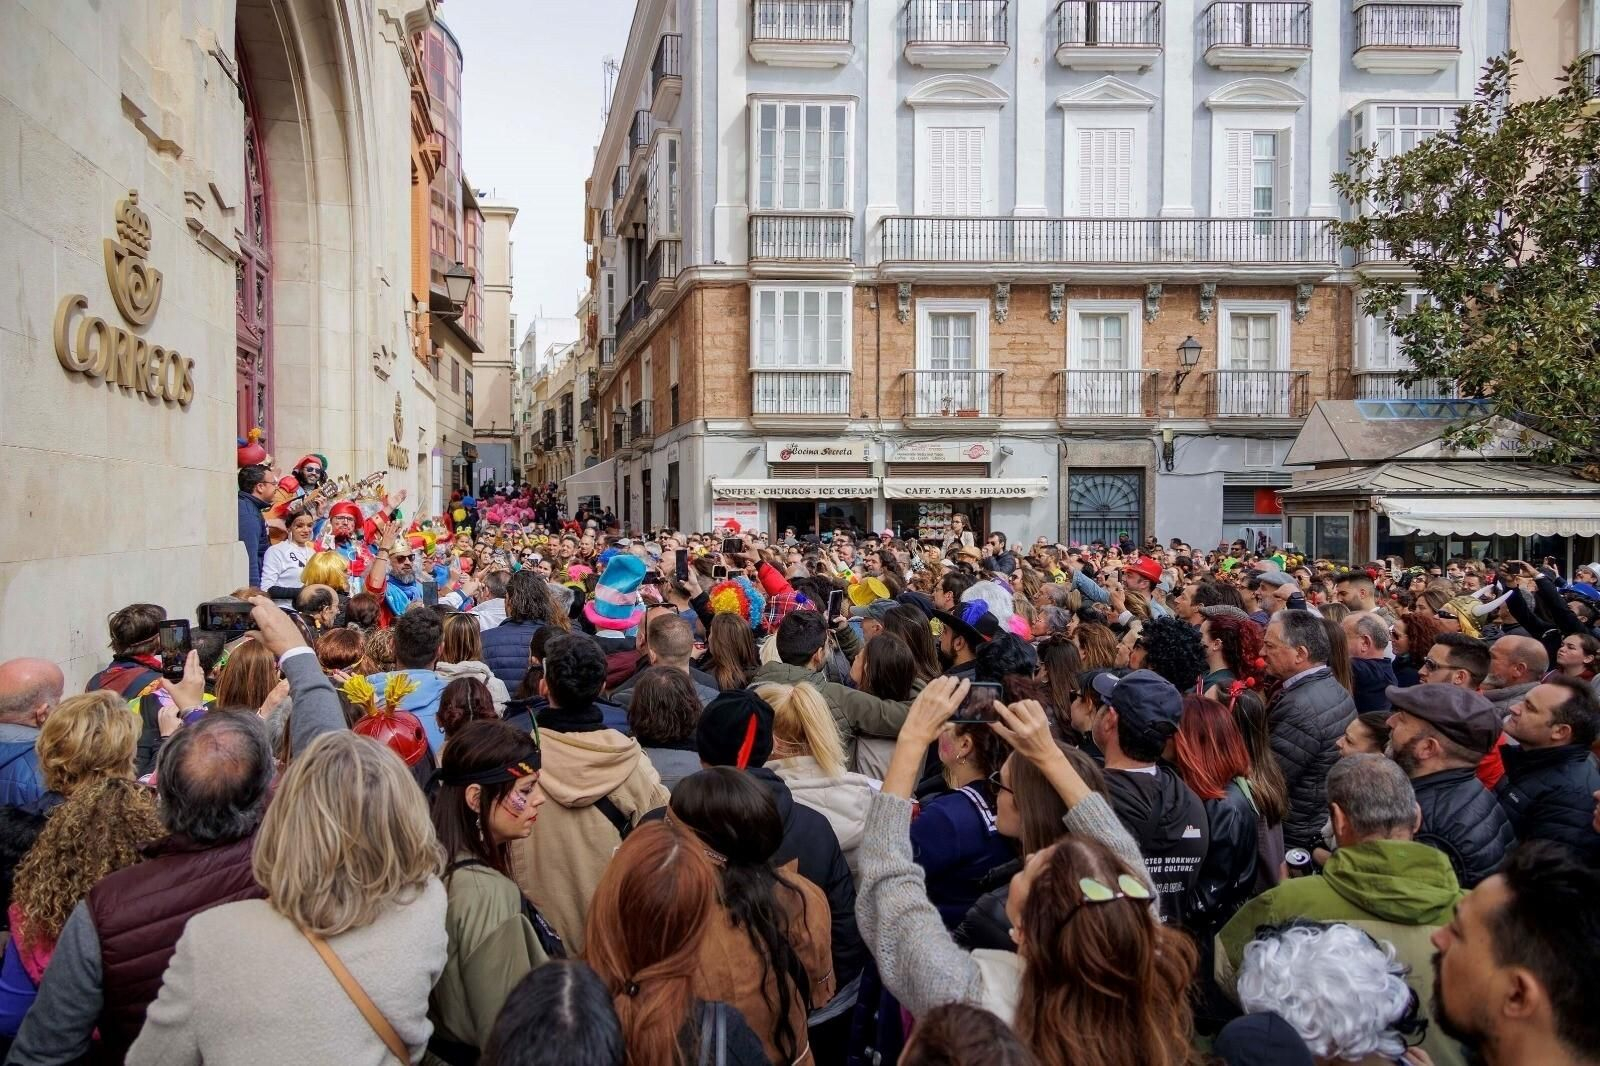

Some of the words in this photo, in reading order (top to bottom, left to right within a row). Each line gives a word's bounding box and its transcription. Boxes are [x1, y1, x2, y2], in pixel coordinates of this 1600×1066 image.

[791, 447, 819, 456] Cocina
[820, 447, 853, 456] Secreta
[718, 487, 756, 495] COFFEE
[763, 487, 811, 495] CHURROS
[818, 487, 836, 495] ICE
[837, 487, 873, 495] CREAM
[905, 487, 931, 495] CAFE
[938, 487, 972, 495] TAPAS
[979, 487, 1026, 495] HELADOS
